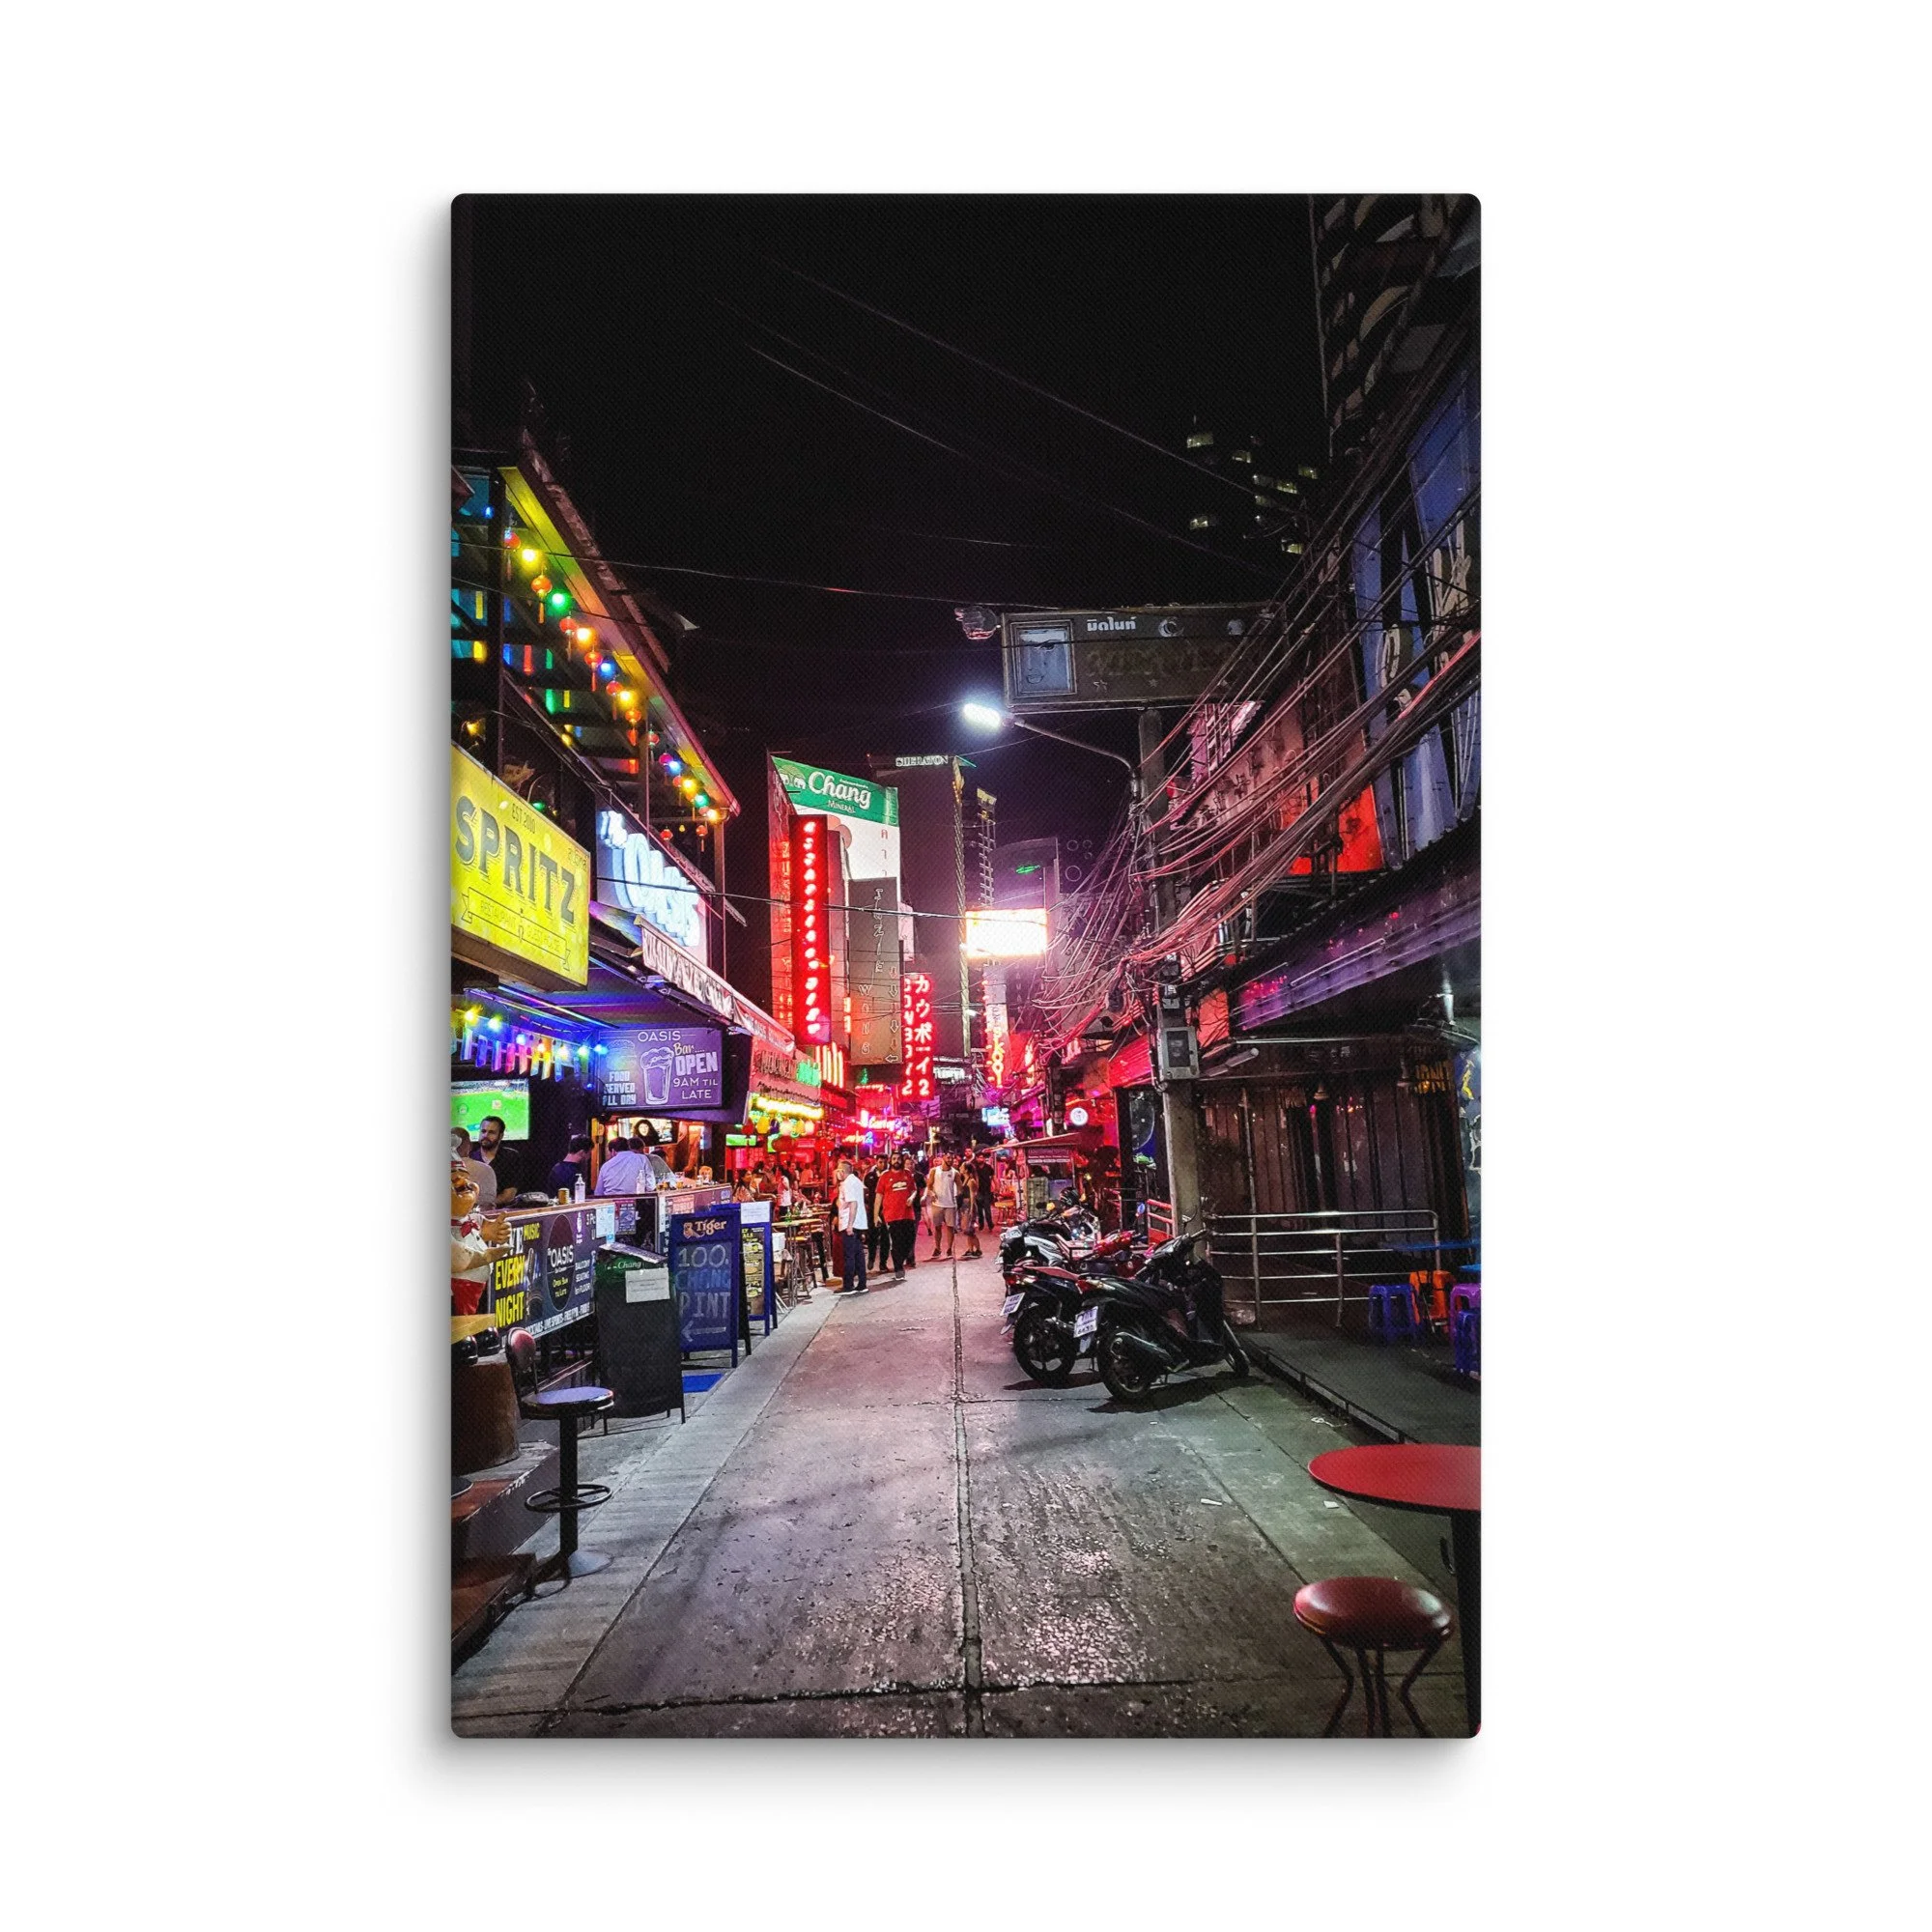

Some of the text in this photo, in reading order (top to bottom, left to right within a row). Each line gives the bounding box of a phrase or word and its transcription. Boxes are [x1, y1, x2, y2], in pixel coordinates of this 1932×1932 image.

[809, 771, 871, 810] Chang
[455, 795, 575, 924] SPRITZ
[638, 1031, 681, 1042] OASIS
[675, 1051, 719, 1076] OPEN
[610, 1070, 631, 1082] FOOD
[673, 1077, 699, 1087] 9AM
[681, 1089, 712, 1099] LATE
[695, 1218, 727, 1236] Tiger
[550, 1244, 574, 1267] OASIS
[617, 1260, 642, 1270] Chang
[495, 1255, 526, 1291] EVERY
[495, 1291, 526, 1328] NIGHT
